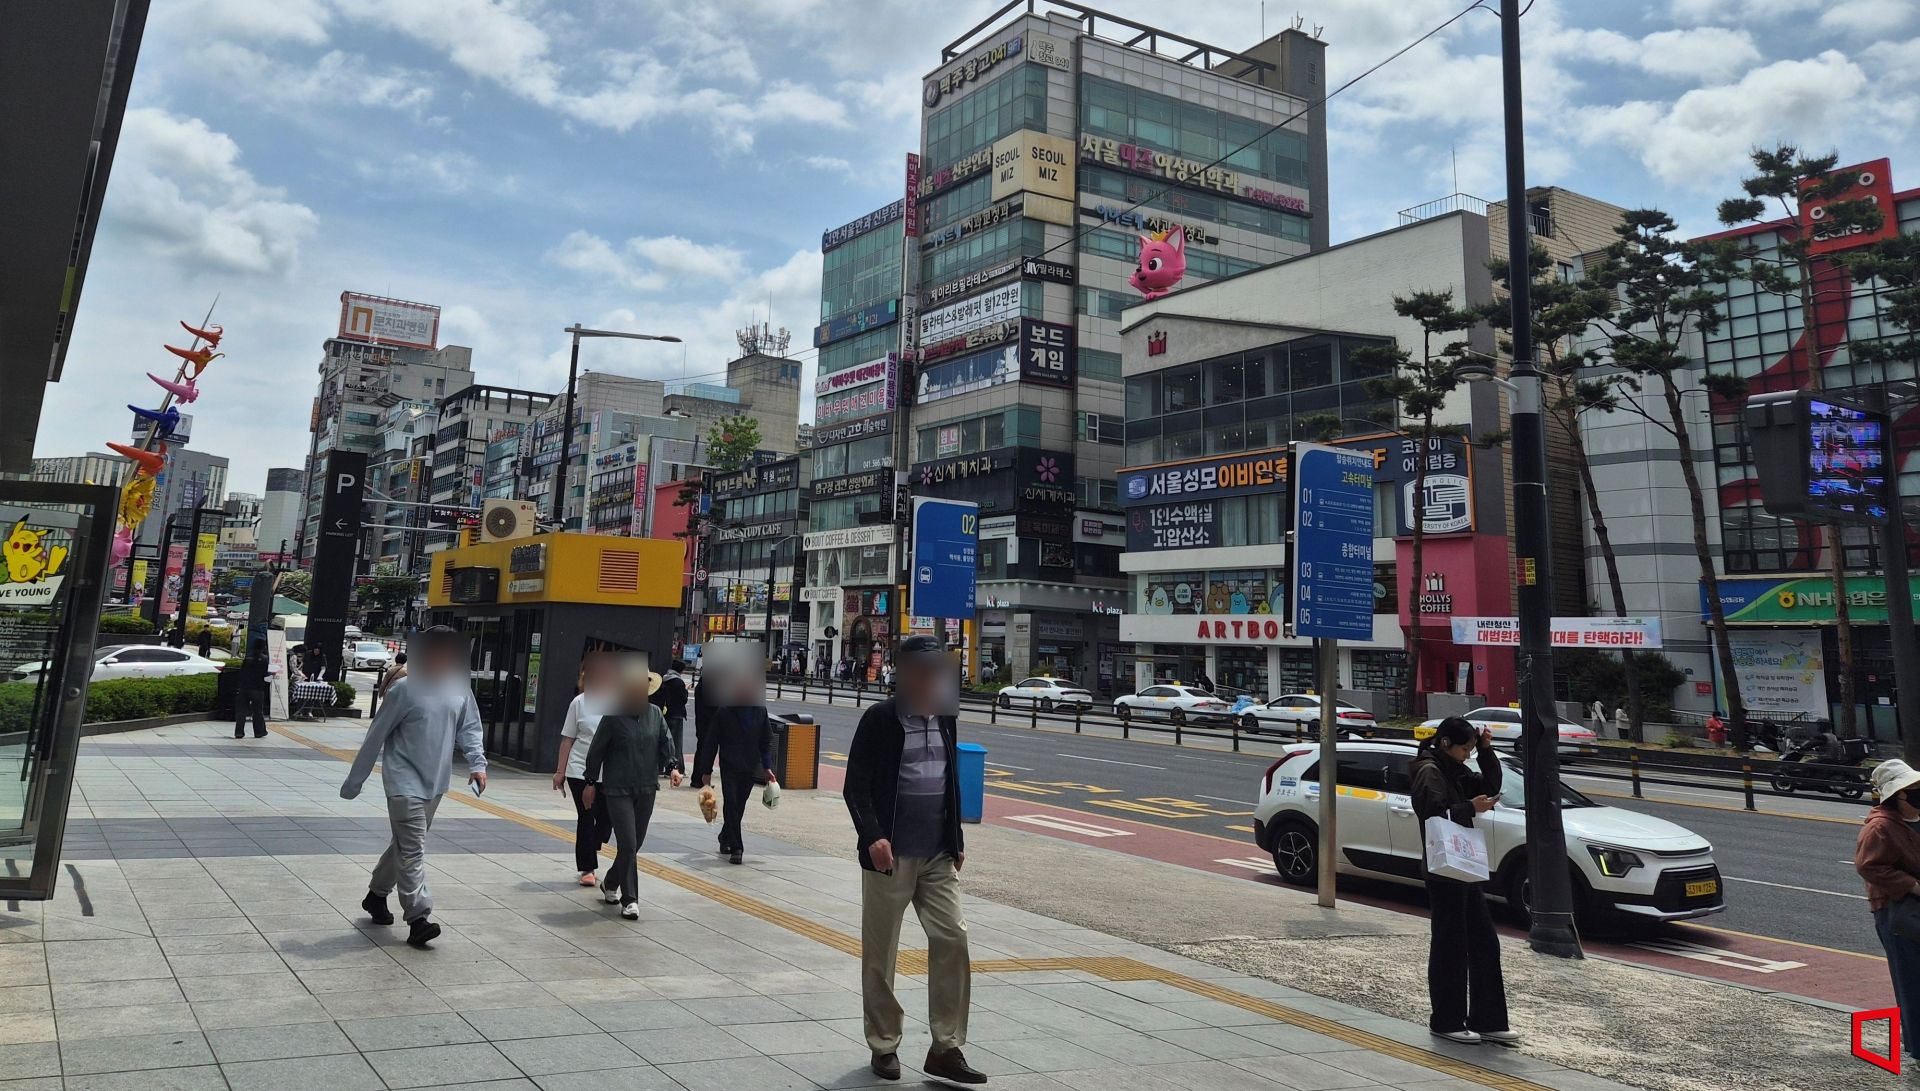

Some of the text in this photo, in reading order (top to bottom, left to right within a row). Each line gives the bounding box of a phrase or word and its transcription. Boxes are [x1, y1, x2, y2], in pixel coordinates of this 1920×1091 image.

[995, 147, 1020, 168] SEOUL
[1032, 147, 1067, 166] SEOUL
[1001, 167, 1014, 183] MIZ
[1039, 166, 1058, 182] MIZ
[1149, 217, 1206, 245] 치과정과
[1030, 325, 1065, 347] 보드
[1030, 348, 1064, 371] 게임
[934, 456, 991, 482] 신세계치과
[1150, 457, 1287, 495] 서울성모이비인후
[336, 473, 356, 494] P
[1342, 471, 1372, 488] 고속터미널
[1025, 487, 1075, 504] 신세계치과
[1302, 488, 1312, 504] 01
[1150, 503, 1213, 527] 1인수액실
[1302, 511, 1313, 527] 02
[762, 523, 782, 536] CAFE
[962, 514, 975, 534] 02
[826, 532, 844, 546] COFFEE
[850, 530, 875, 544] DESSERT
[1342, 543, 1372, 560] 종합터미널
[1301, 562, 1311, 578] 03
[15, 588, 51, 597] YOUNG
[822, 589, 837, 598] COFFEE
[1301, 585, 1311, 601] 04
[1419, 594, 1451, 603] HOLLYS
[1797, 592, 1887, 607] NH협은
[986, 595, 1010, 608] kt plaza
[1092, 600, 1123, 616] kt plaza
[1420, 603, 1451, 613] COFFEE
[1300, 608, 1310, 624] 05
[1198, 620, 1278, 640] ARTBO
[1551, 631, 1579, 645] 대를
[1584, 631, 1643, 645] 탄핵하라!
